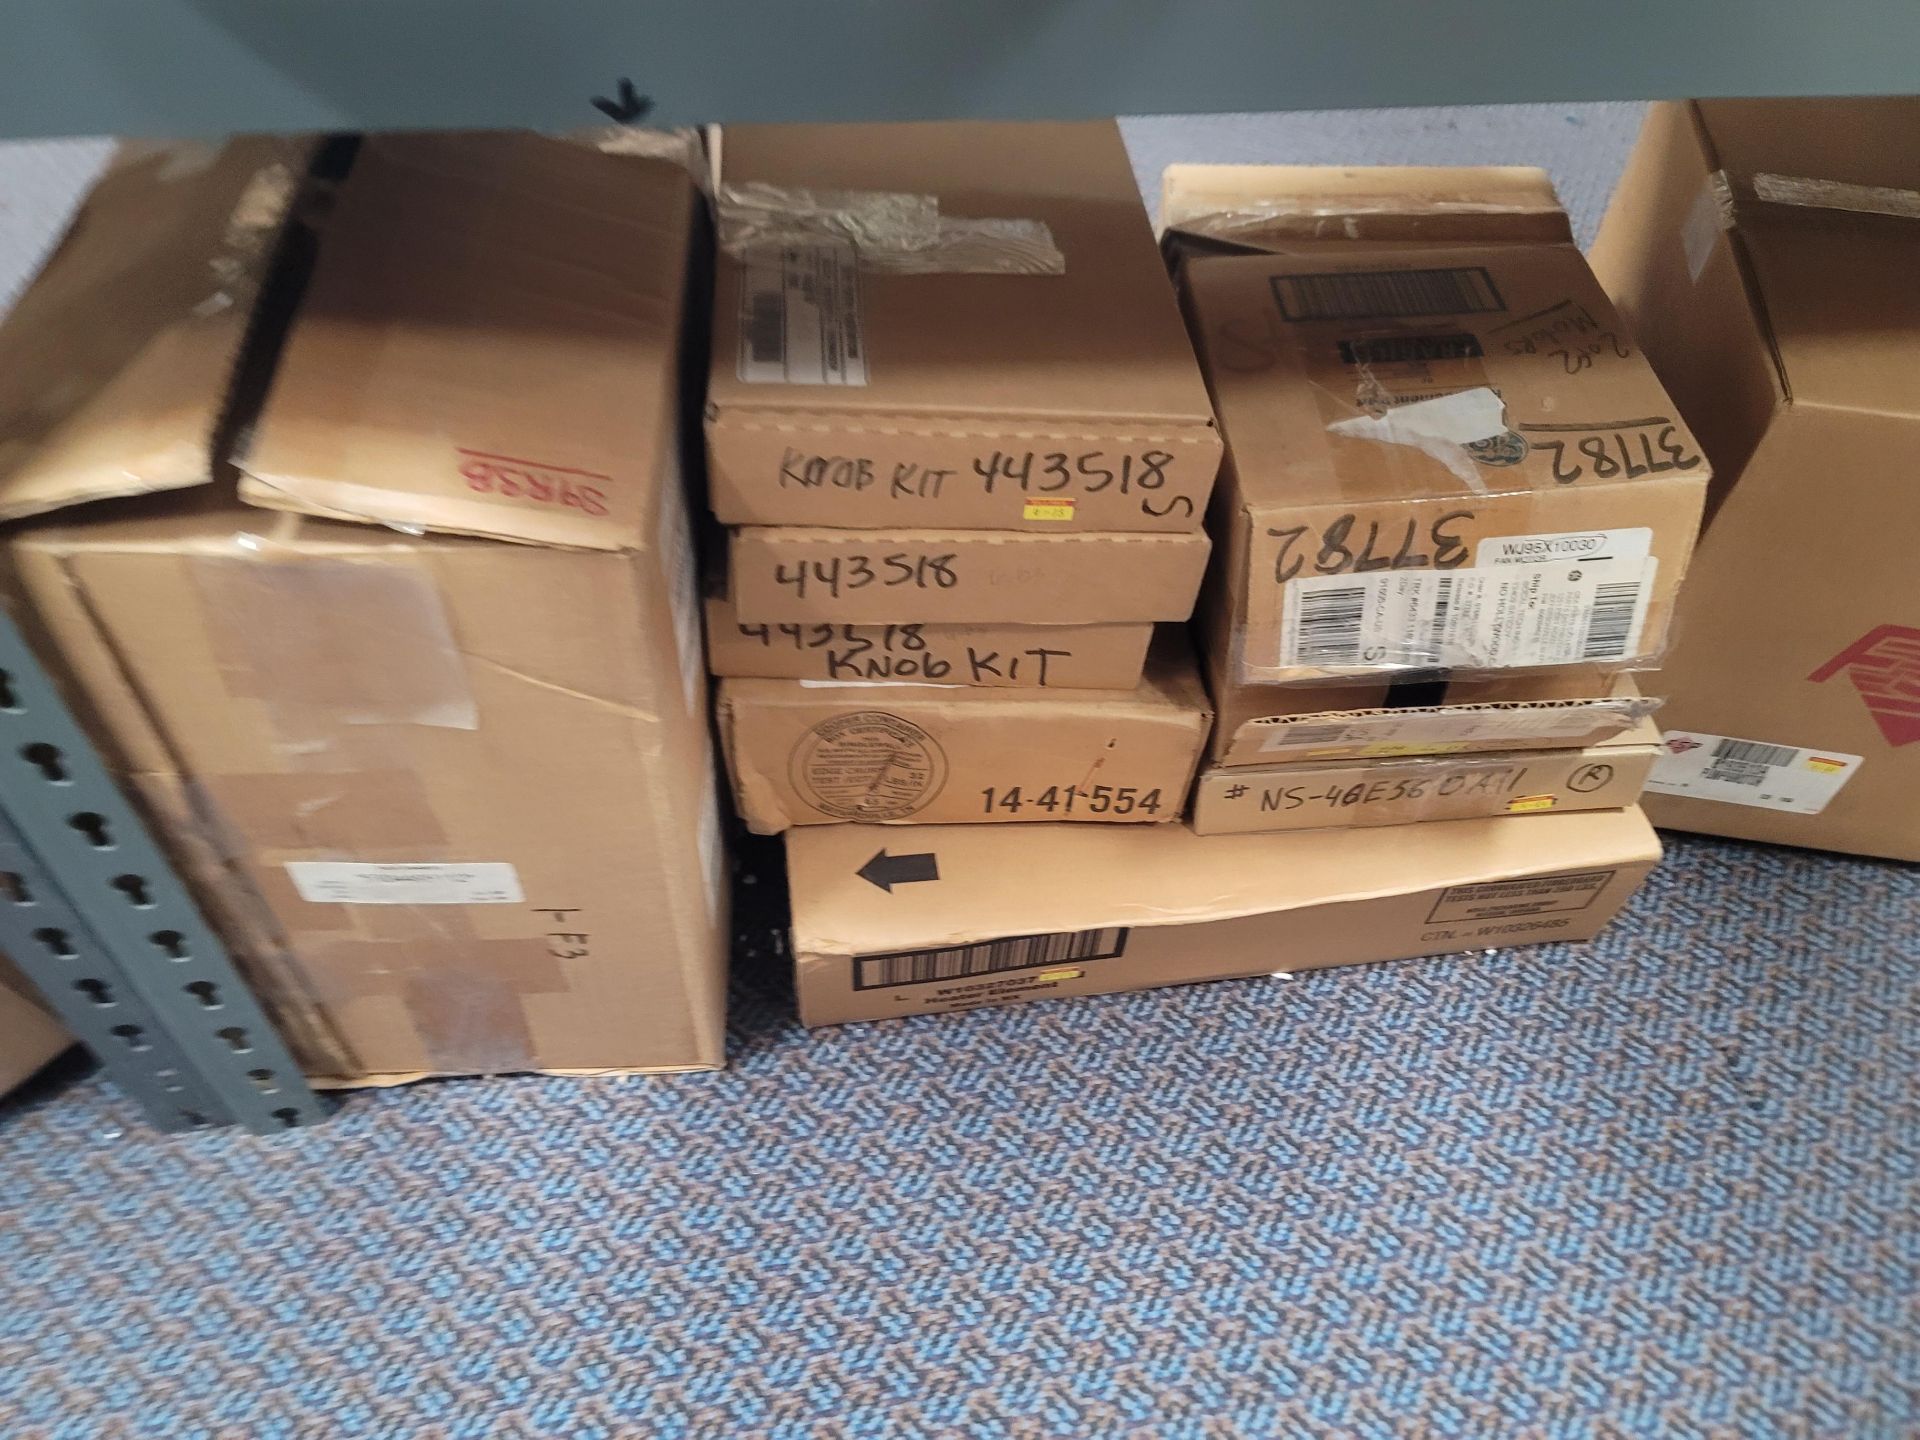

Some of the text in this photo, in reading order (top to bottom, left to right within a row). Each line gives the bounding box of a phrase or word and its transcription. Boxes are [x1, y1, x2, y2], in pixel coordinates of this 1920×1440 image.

[891, 462, 957, 498] KIT
[972, 451, 1176, 494] 443518
[1530, 425, 1700, 485] 37782
[1267, 510, 1476, 584] 37782
[1502, 538, 1597, 556] WJ95X10030
[775, 553, 958, 599] 443518
[1529, 573, 1542, 594] Ship
[1487, 598, 1507, 656] HOLLYWOOD
[1224, 784, 1249, 800] #
